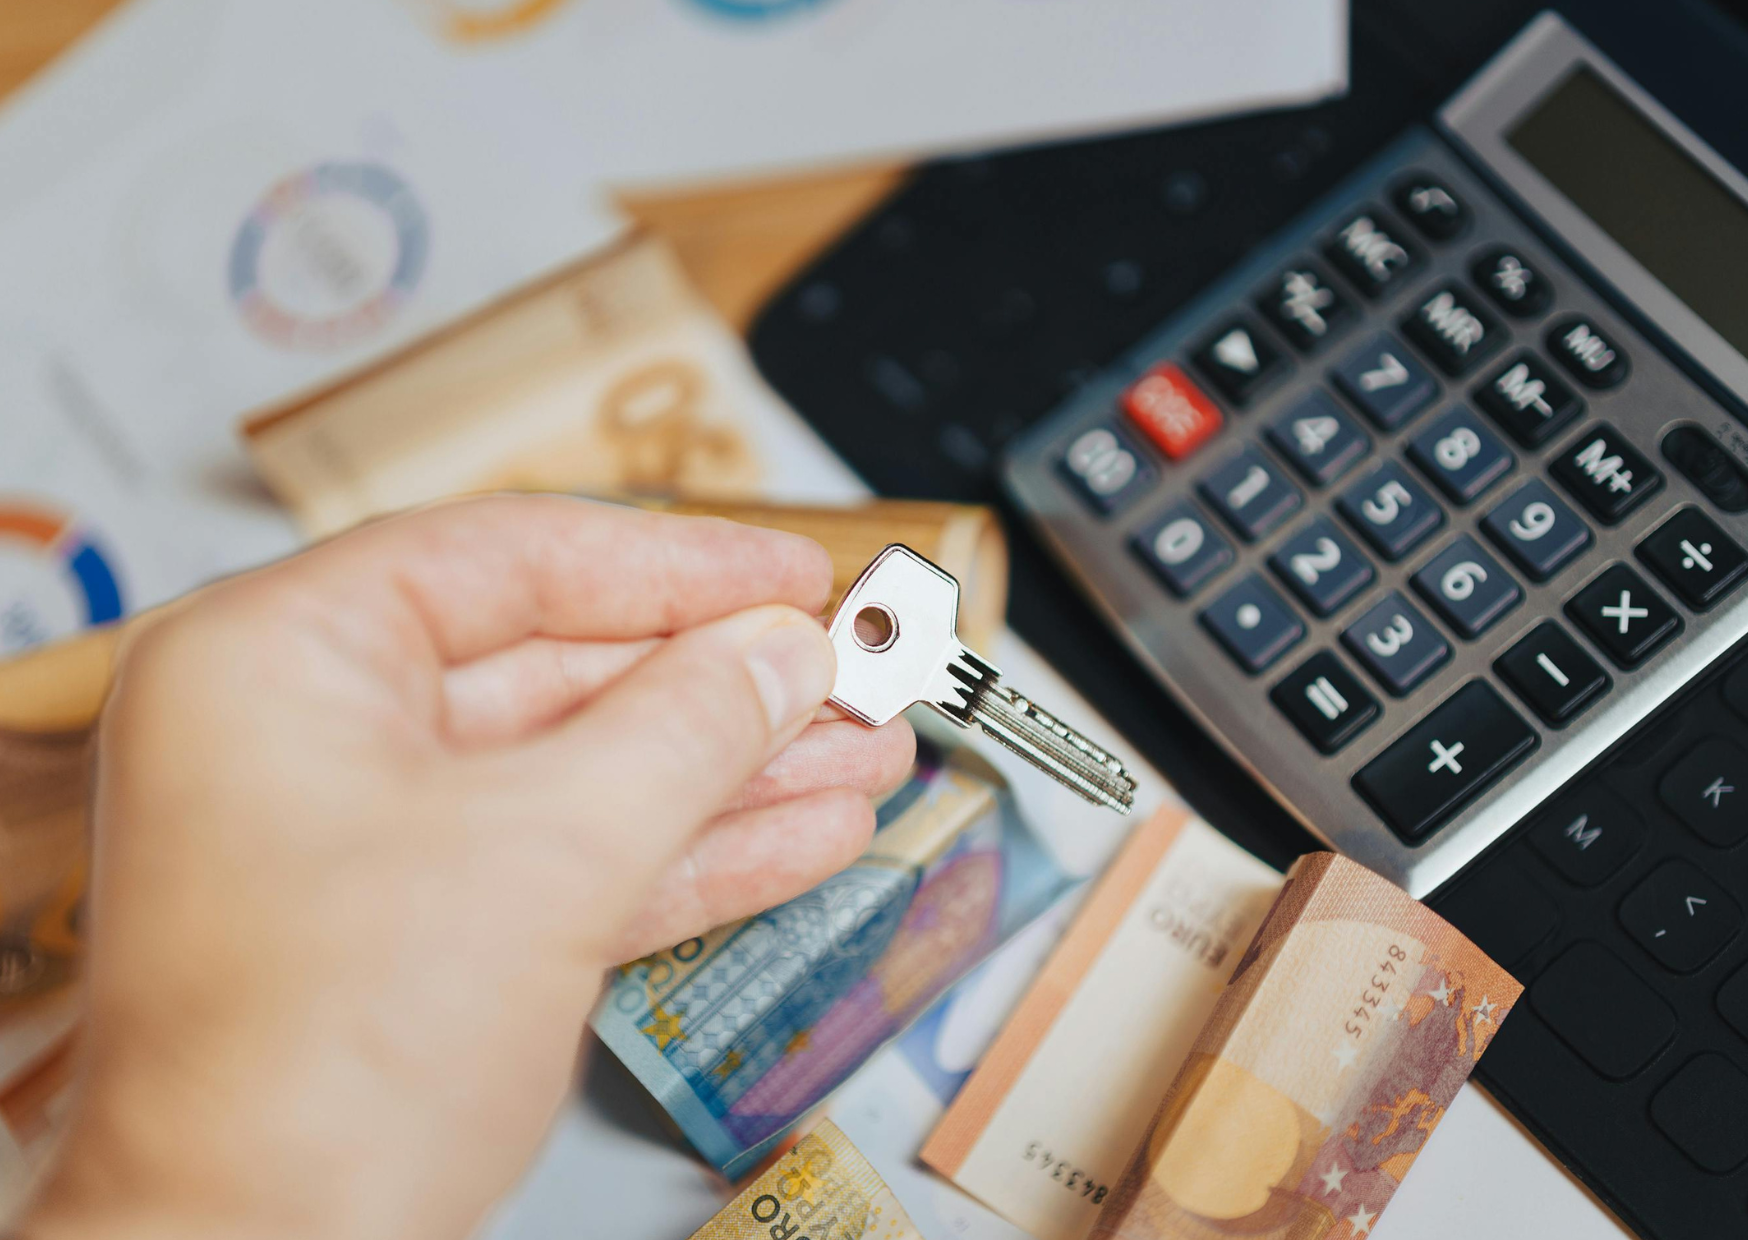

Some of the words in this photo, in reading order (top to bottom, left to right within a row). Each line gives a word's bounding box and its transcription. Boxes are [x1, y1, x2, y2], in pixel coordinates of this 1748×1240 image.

[1341, 217, 1408, 281] MC
[1423, 293, 1483, 352] MR
[1565, 325, 1613, 370] MU
[1361, 354, 1408, 391] 7
[1295, 416, 1339, 454] 4
[1436, 427, 1481, 470] 8
[1068, 429, 1136, 493] 00
[1576, 439, 1632, 492] M+
[1229, 466, 1269, 507] 1
[1364, 481, 1412, 524] 5
[1155, 518, 1204, 563] 0
[1511, 502, 1556, 541] 9
[1292, 537, 1341, 584] 2
[1442, 561, 1487, 600] 6
[1368, 614, 1414, 656] 3
[1704, 778, 1733, 807] K
[1567, 815, 1601, 849] M
[1344, 944, 1406, 1039] 843345
[1021, 1140, 1108, 1205] 843345
